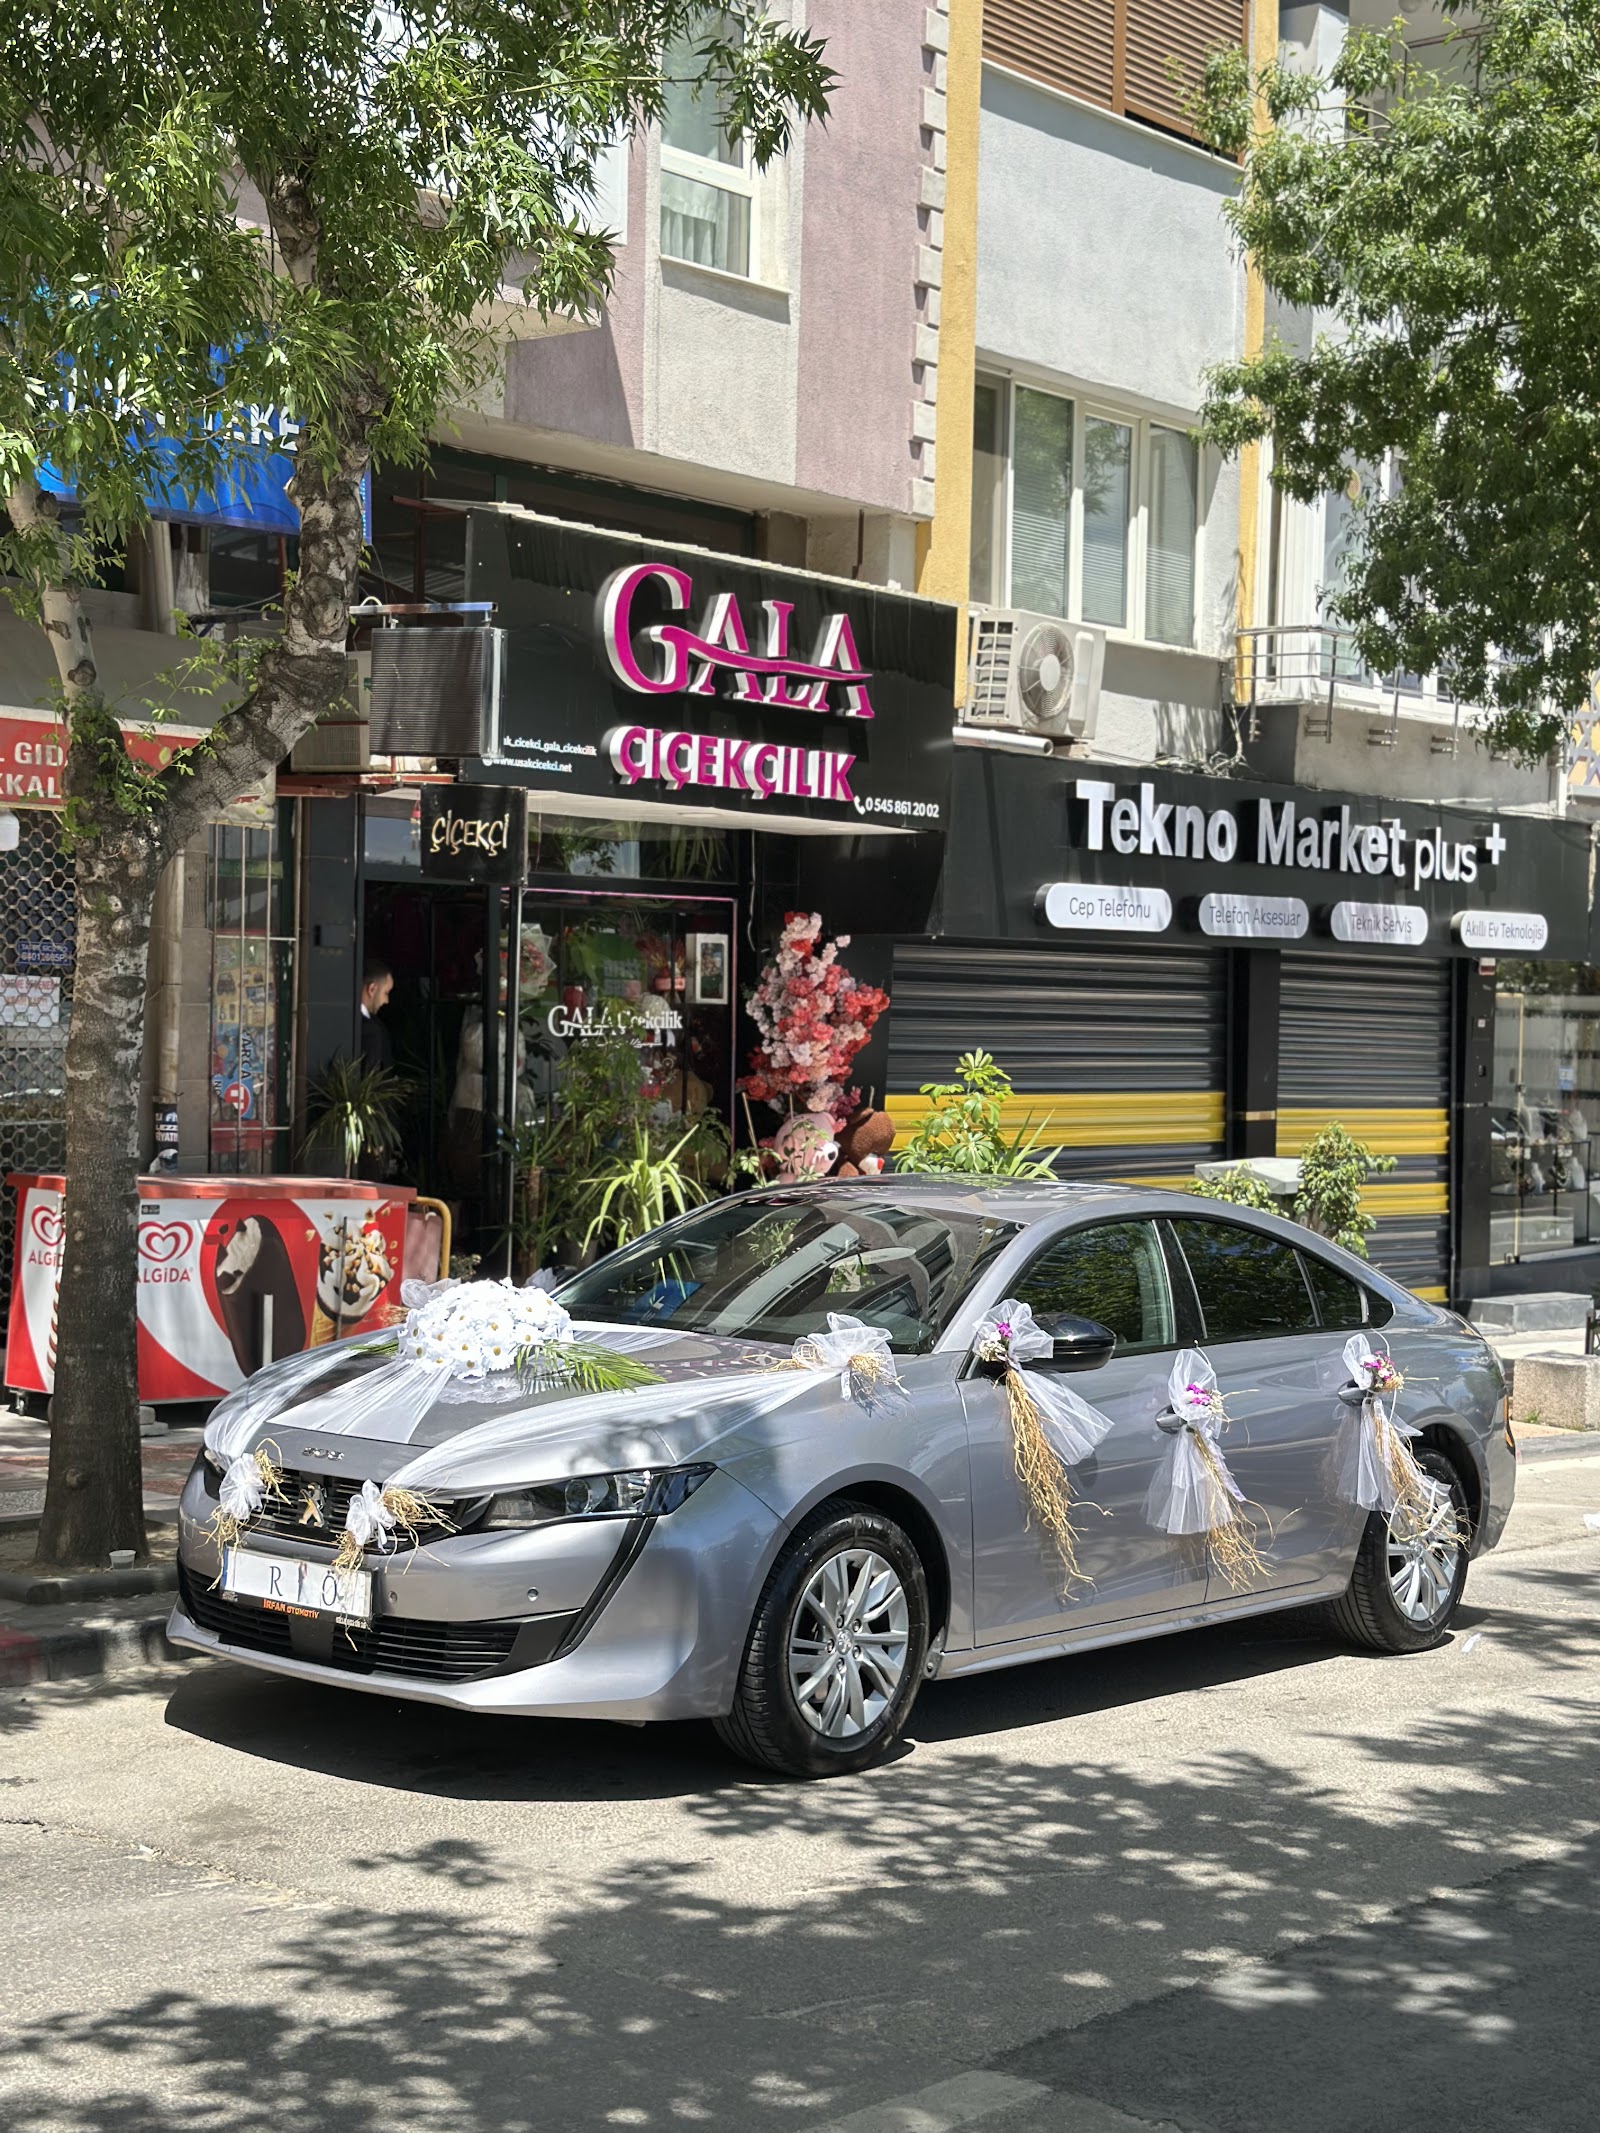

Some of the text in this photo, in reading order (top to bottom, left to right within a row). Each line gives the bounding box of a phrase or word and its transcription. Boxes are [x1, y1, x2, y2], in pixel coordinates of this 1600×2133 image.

[604, 563, 875, 719] GALA
[14, 741, 68, 767] GID
[0, 771, 62, 799] KAL
[1075, 779, 1238, 862] Tekno
[1257, 798, 1406, 878] Market
[1414, 826, 1478, 891] plus
[1069, 896, 1151, 919] Cep Telefonu
[1209, 905, 1302, 928] Telefon Aksesuar
[1351, 914, 1412, 934] Teknik Servis
[1488, 923, 1499, 938] Ev
[1501, 923, 1546, 944] Teknolojisi
[547, 1005, 617, 1037] GALA
[136, 1268, 191, 1284] LGiDA
[269, 1566, 284, 1597] R
